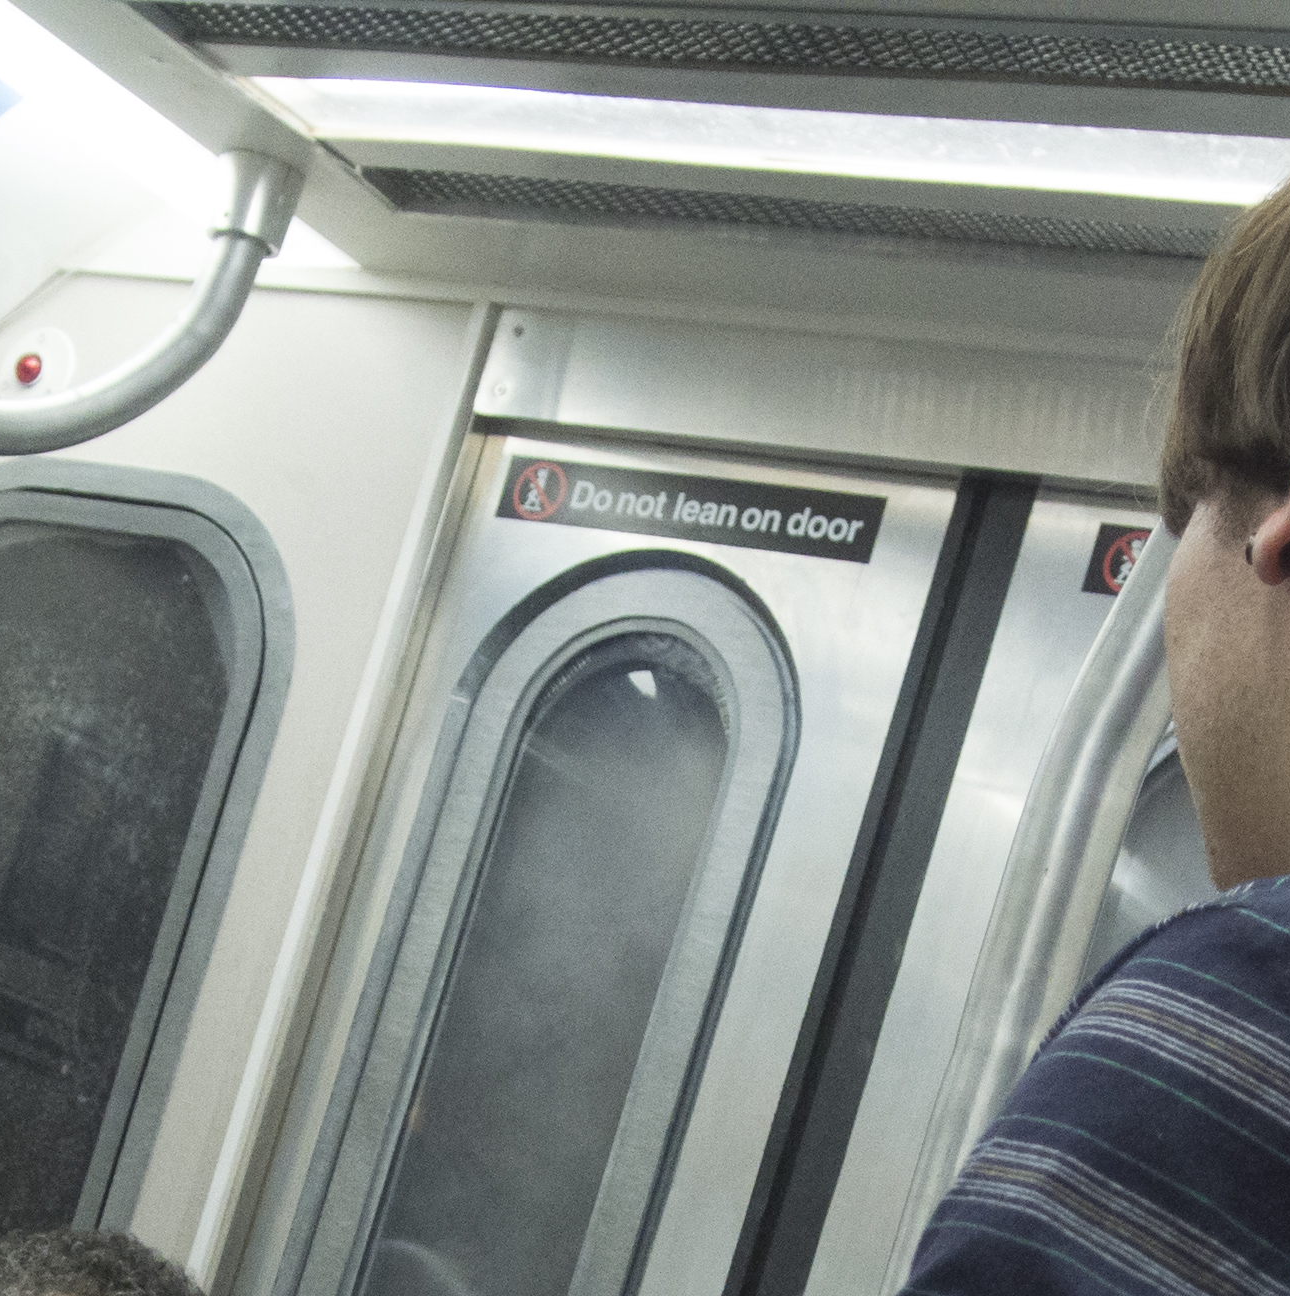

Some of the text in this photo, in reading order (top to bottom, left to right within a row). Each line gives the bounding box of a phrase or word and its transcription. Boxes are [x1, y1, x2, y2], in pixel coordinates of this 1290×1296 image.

[568, 479, 866, 544] Do not lean on door
